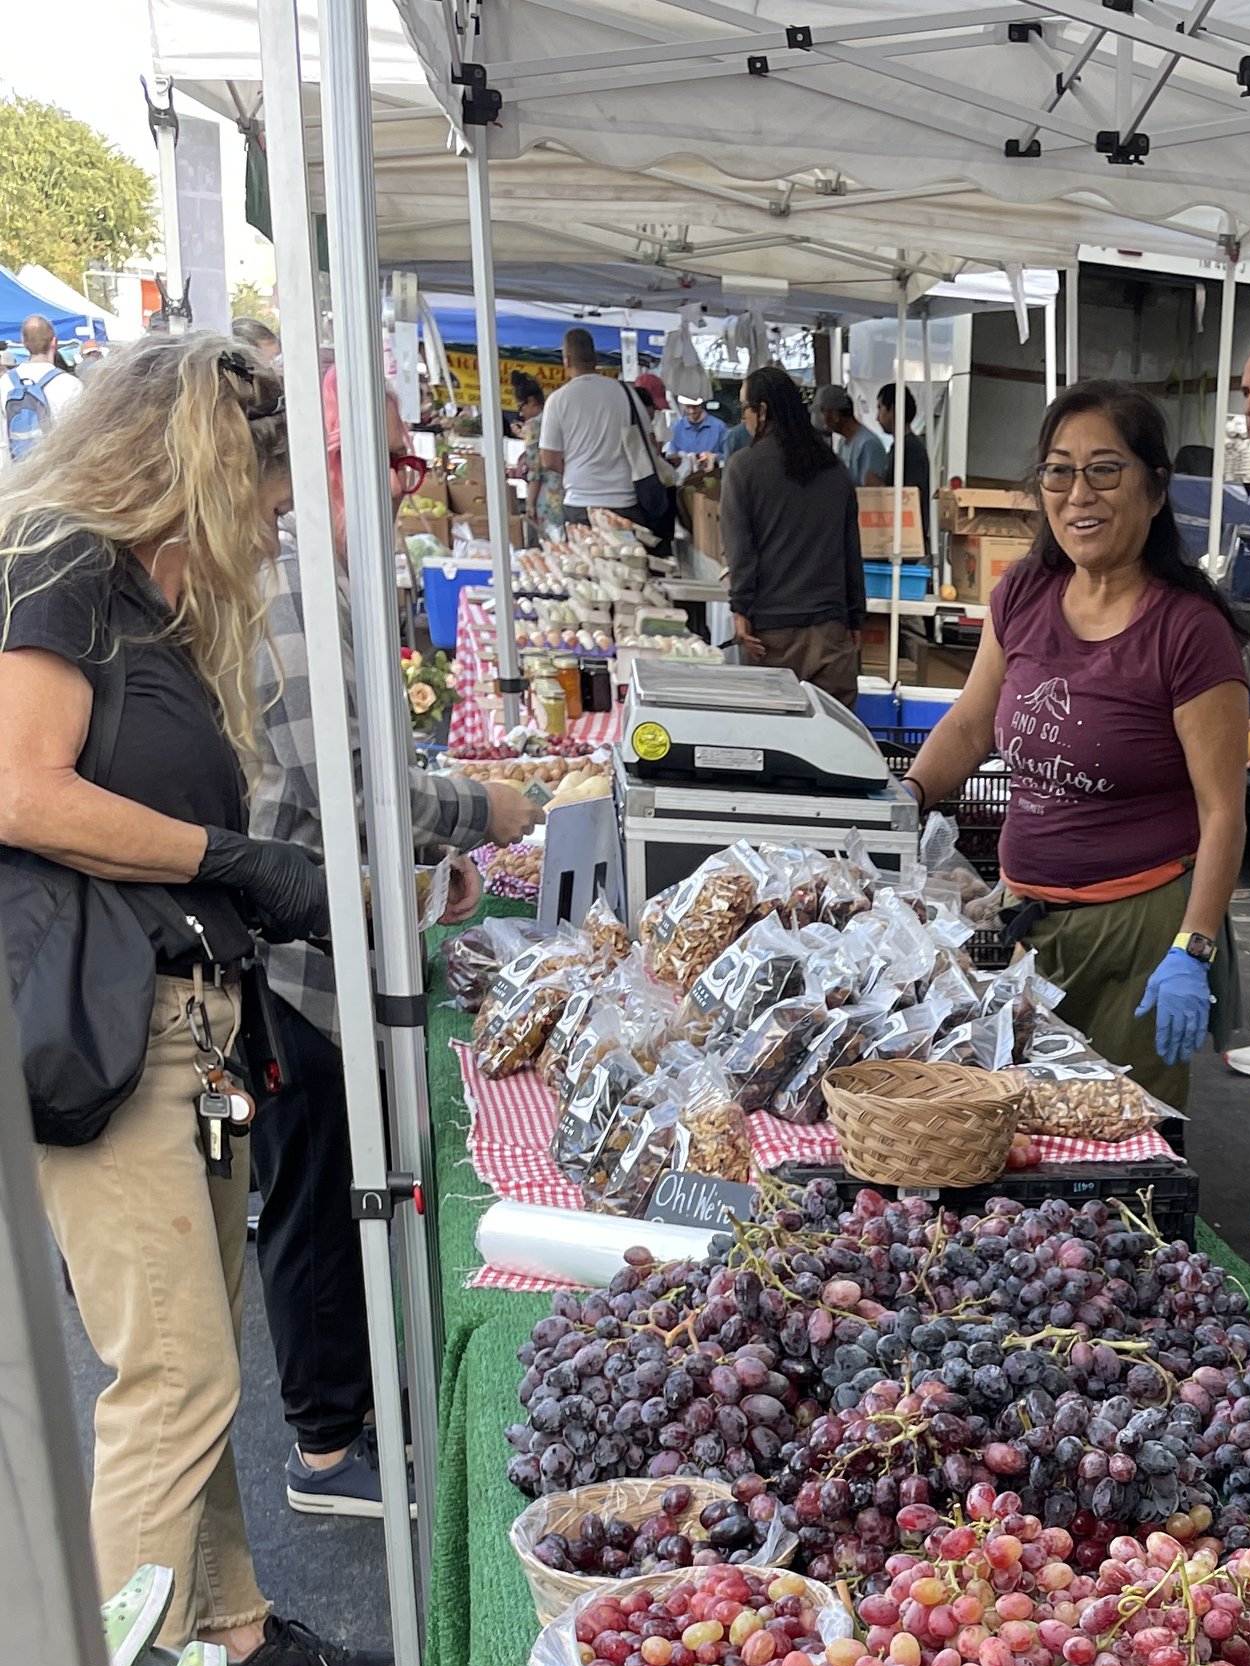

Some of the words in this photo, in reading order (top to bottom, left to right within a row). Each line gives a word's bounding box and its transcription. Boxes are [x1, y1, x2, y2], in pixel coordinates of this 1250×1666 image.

[1011, 711, 1037, 735] AND
[1040, 722, 1072, 749] SO...
[655, 1174, 698, 1218] Oh!
